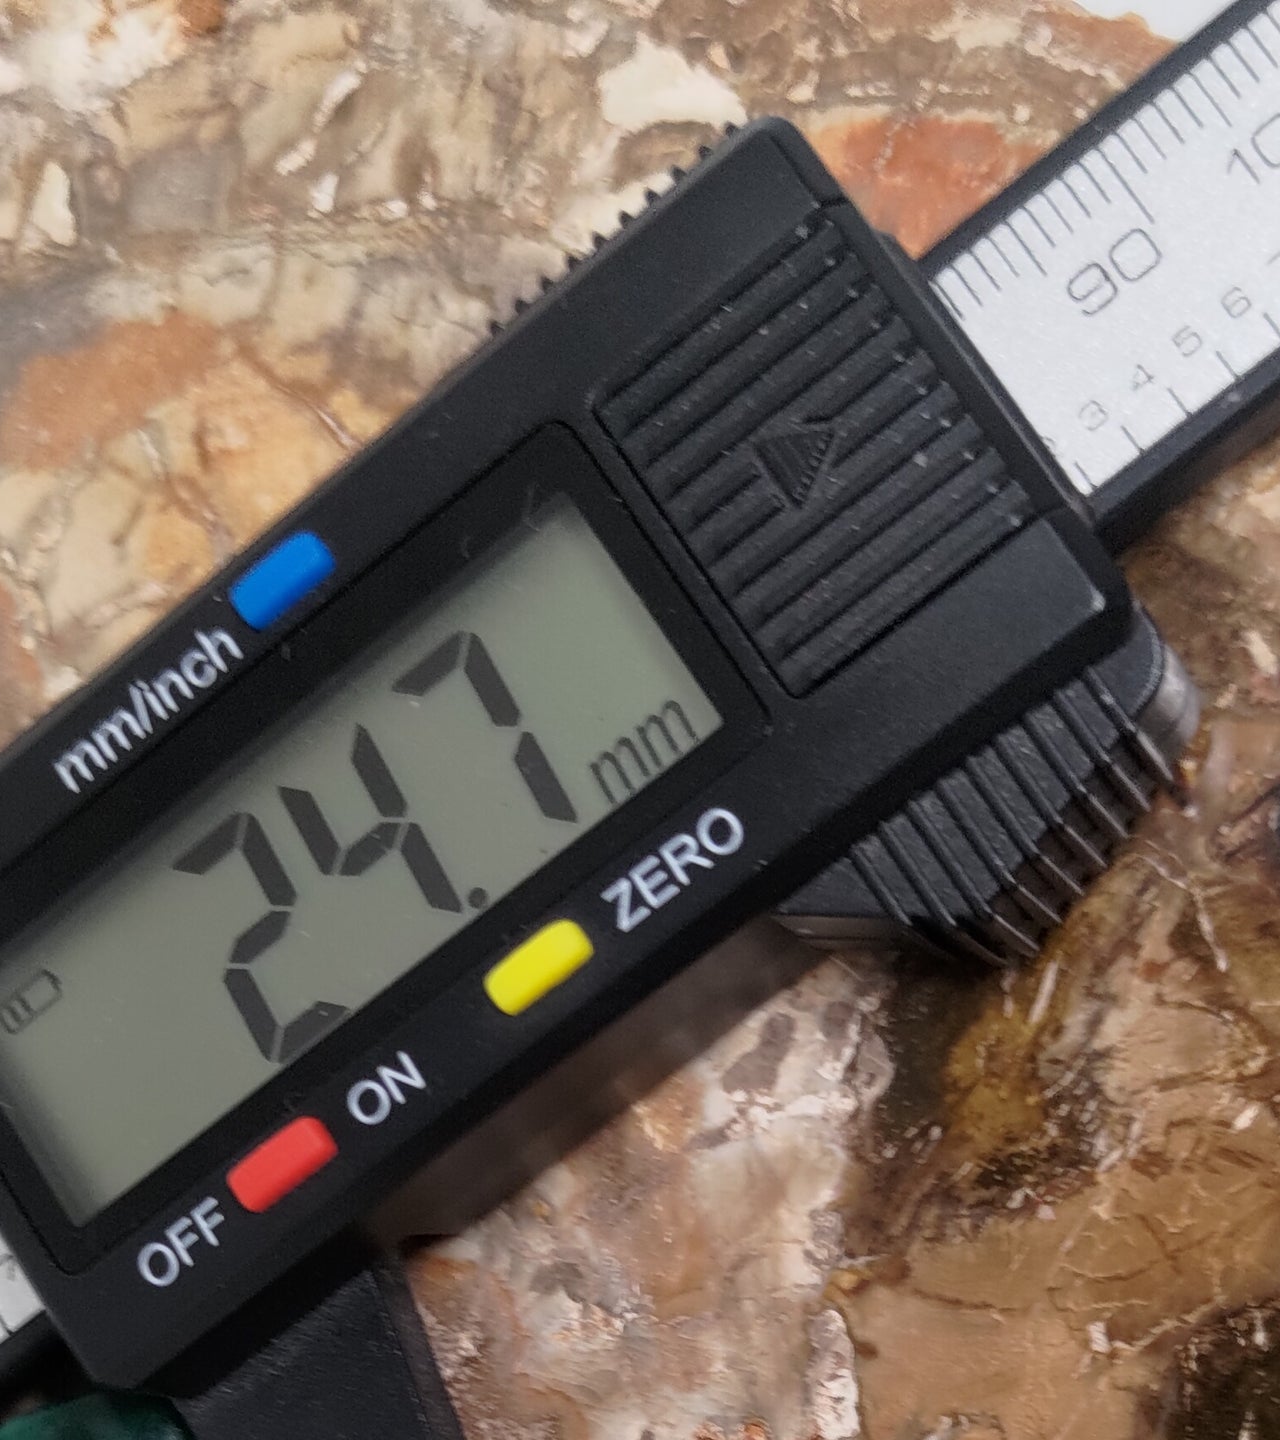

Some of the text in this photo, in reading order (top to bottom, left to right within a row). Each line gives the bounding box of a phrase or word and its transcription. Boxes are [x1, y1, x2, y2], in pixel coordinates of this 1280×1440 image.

[1065, 227, 1163, 317] 90
[1077, 400, 1109, 432] 3
[1130, 363, 1156, 392] 4
[1170, 324, 1203, 358] 5
[1219, 285, 1253, 319] 6
[53, 621, 244, 794] mm/inch
[171, 630, 701, 1064] 24.7 mm
[600, 806, 745, 934] ZERO
[345, 1050, 427, 1127] ON
[137, 1197, 229, 1289] OFF
